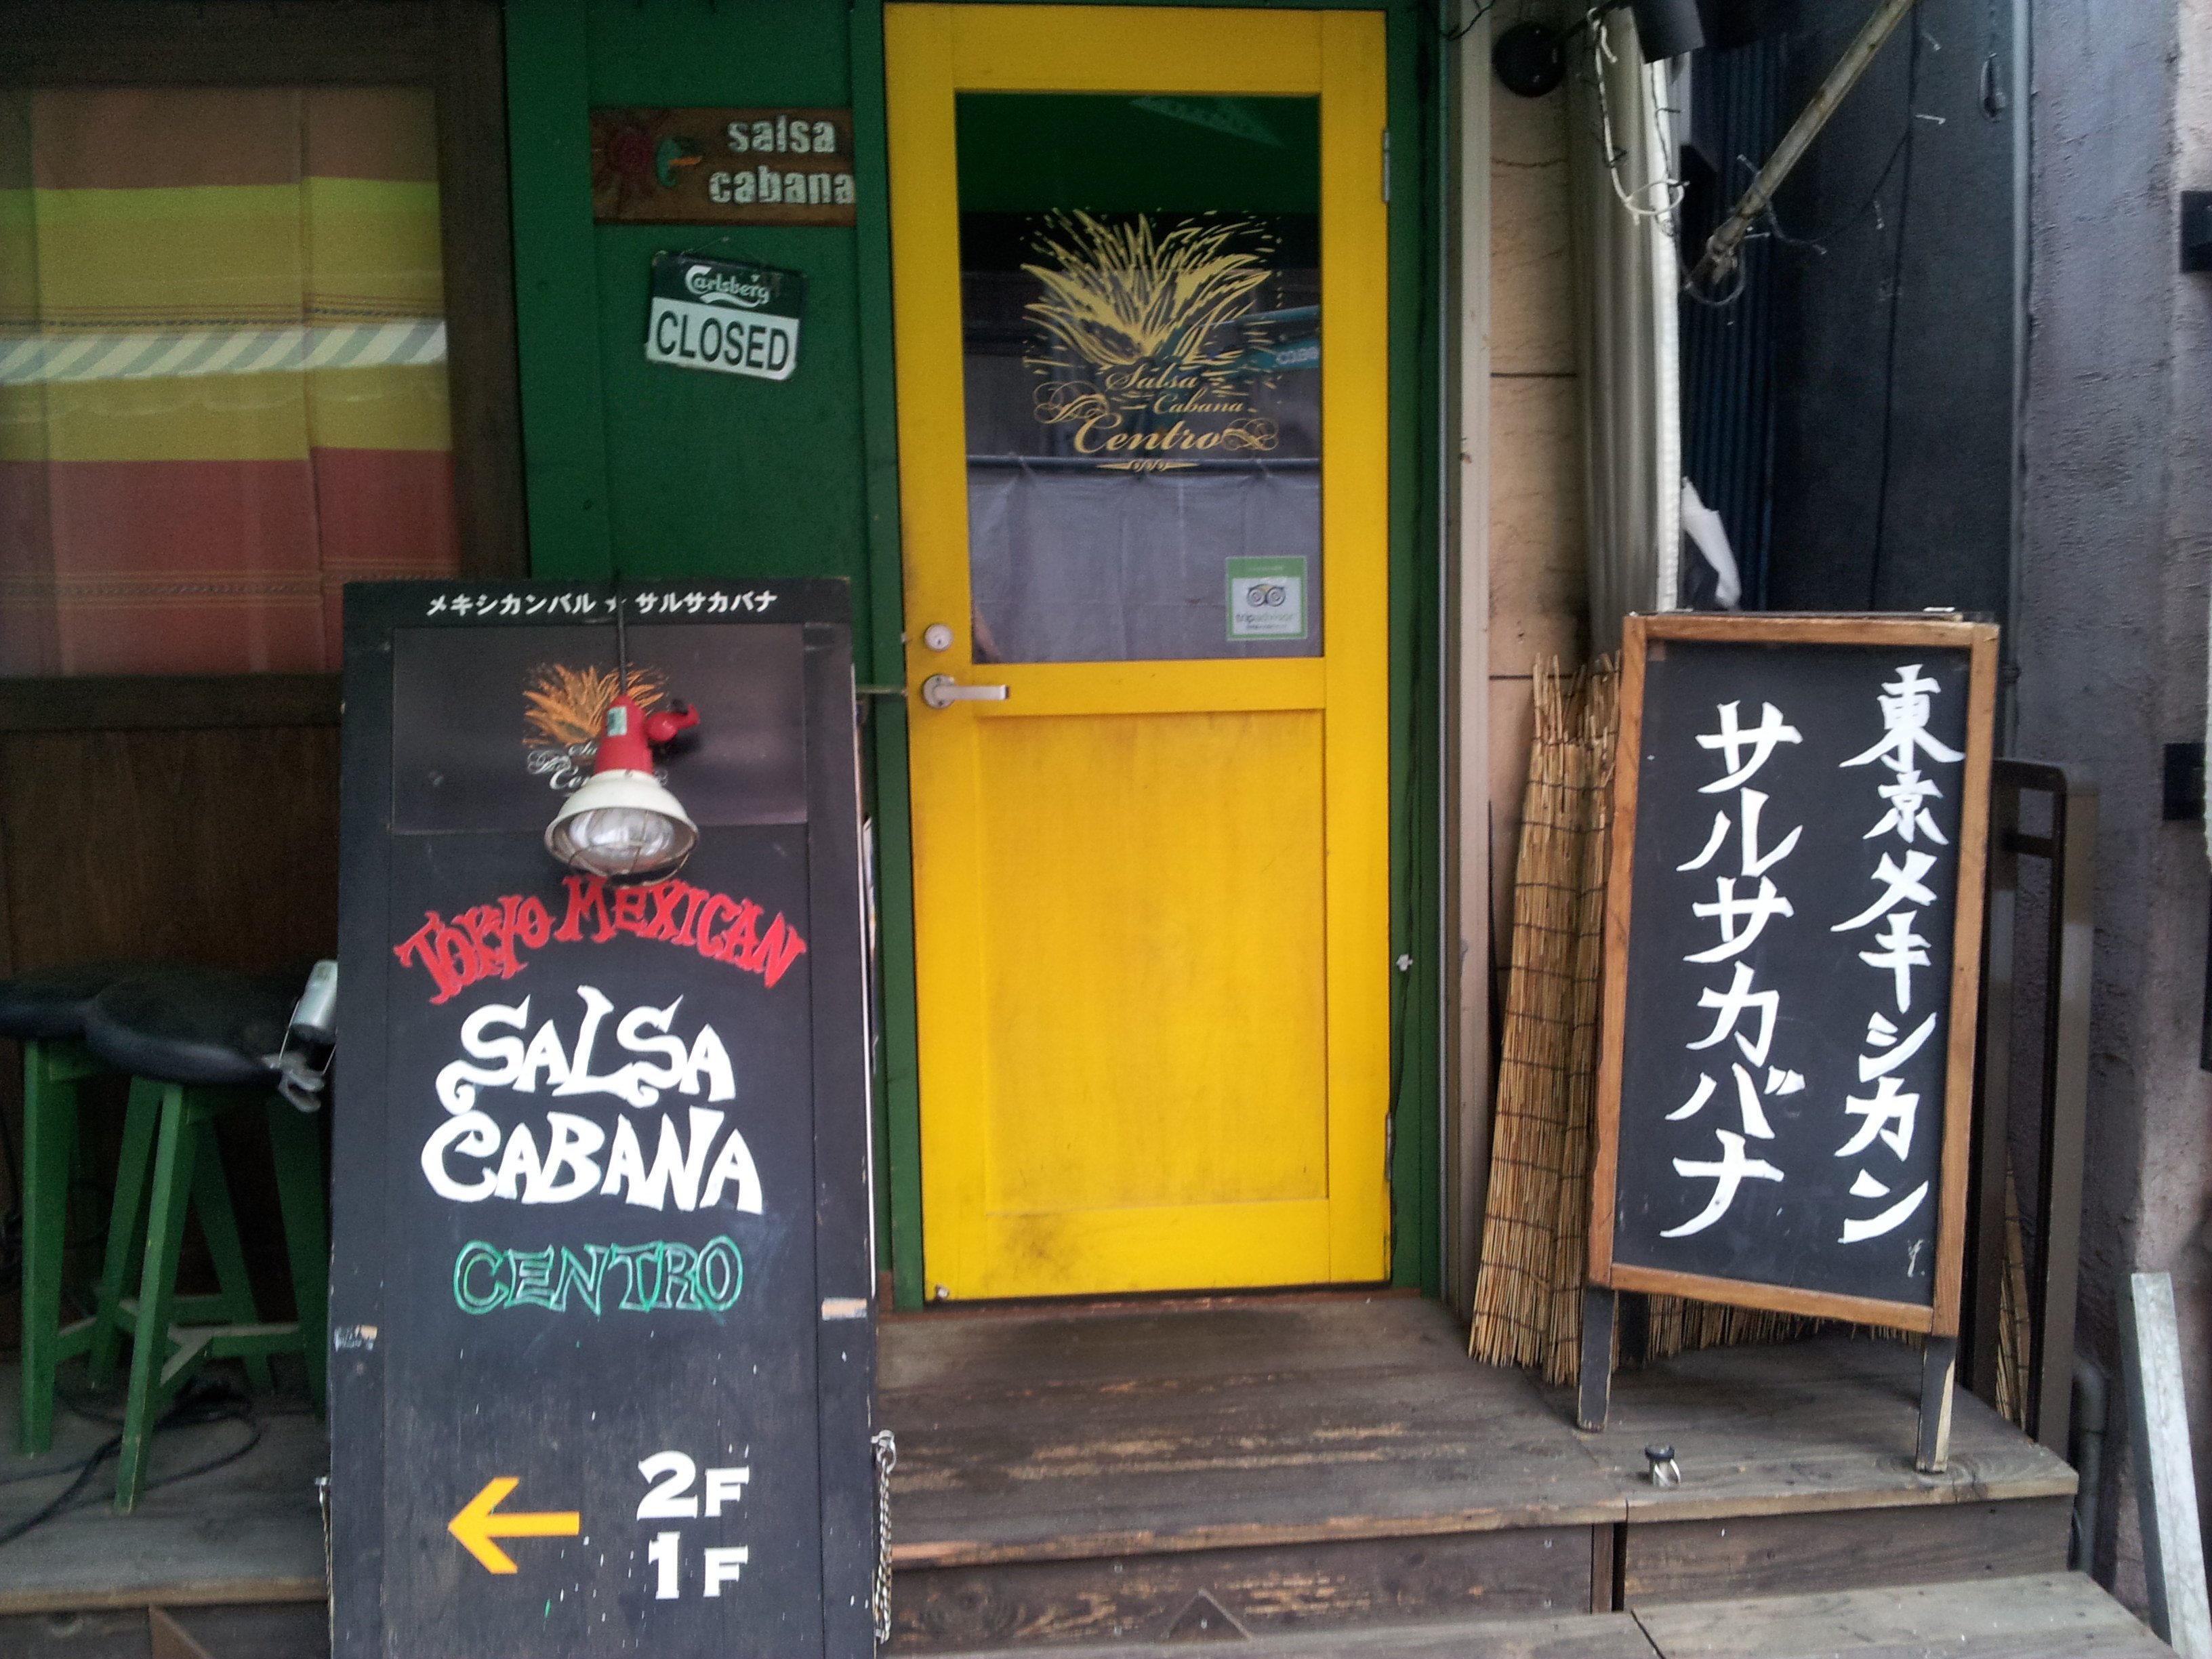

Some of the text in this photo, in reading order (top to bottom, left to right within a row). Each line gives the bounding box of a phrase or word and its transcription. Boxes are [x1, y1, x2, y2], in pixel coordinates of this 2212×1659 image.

[727, 115, 836, 153] salsa
[708, 165, 855, 205] cabana
[684, 264, 770, 306] Carlsberg
[656, 310, 789, 371] CLOSED
[1105, 363, 1202, 391] Salsa
[1153, 386, 1245, 415] Cabana
[1073, 411, 1222, 453] Centro
[426, 589, 779, 617] メキシカンバル サルサカバナ
[393, 874, 807, 1004] TOKYO MEXICAN
[1659, 699, 1806, 1238] サルサカバナ
[1830, 663, 1965, 1244] 東京メキシカン
[436, 985, 736, 1115] SALSA
[421, 1105, 762, 1214] CABANA
[453, 1234, 743, 1316] CENTRO
[636, 1450, 750, 1521] 2F
[649, 1532, 749, 1599] 1F
